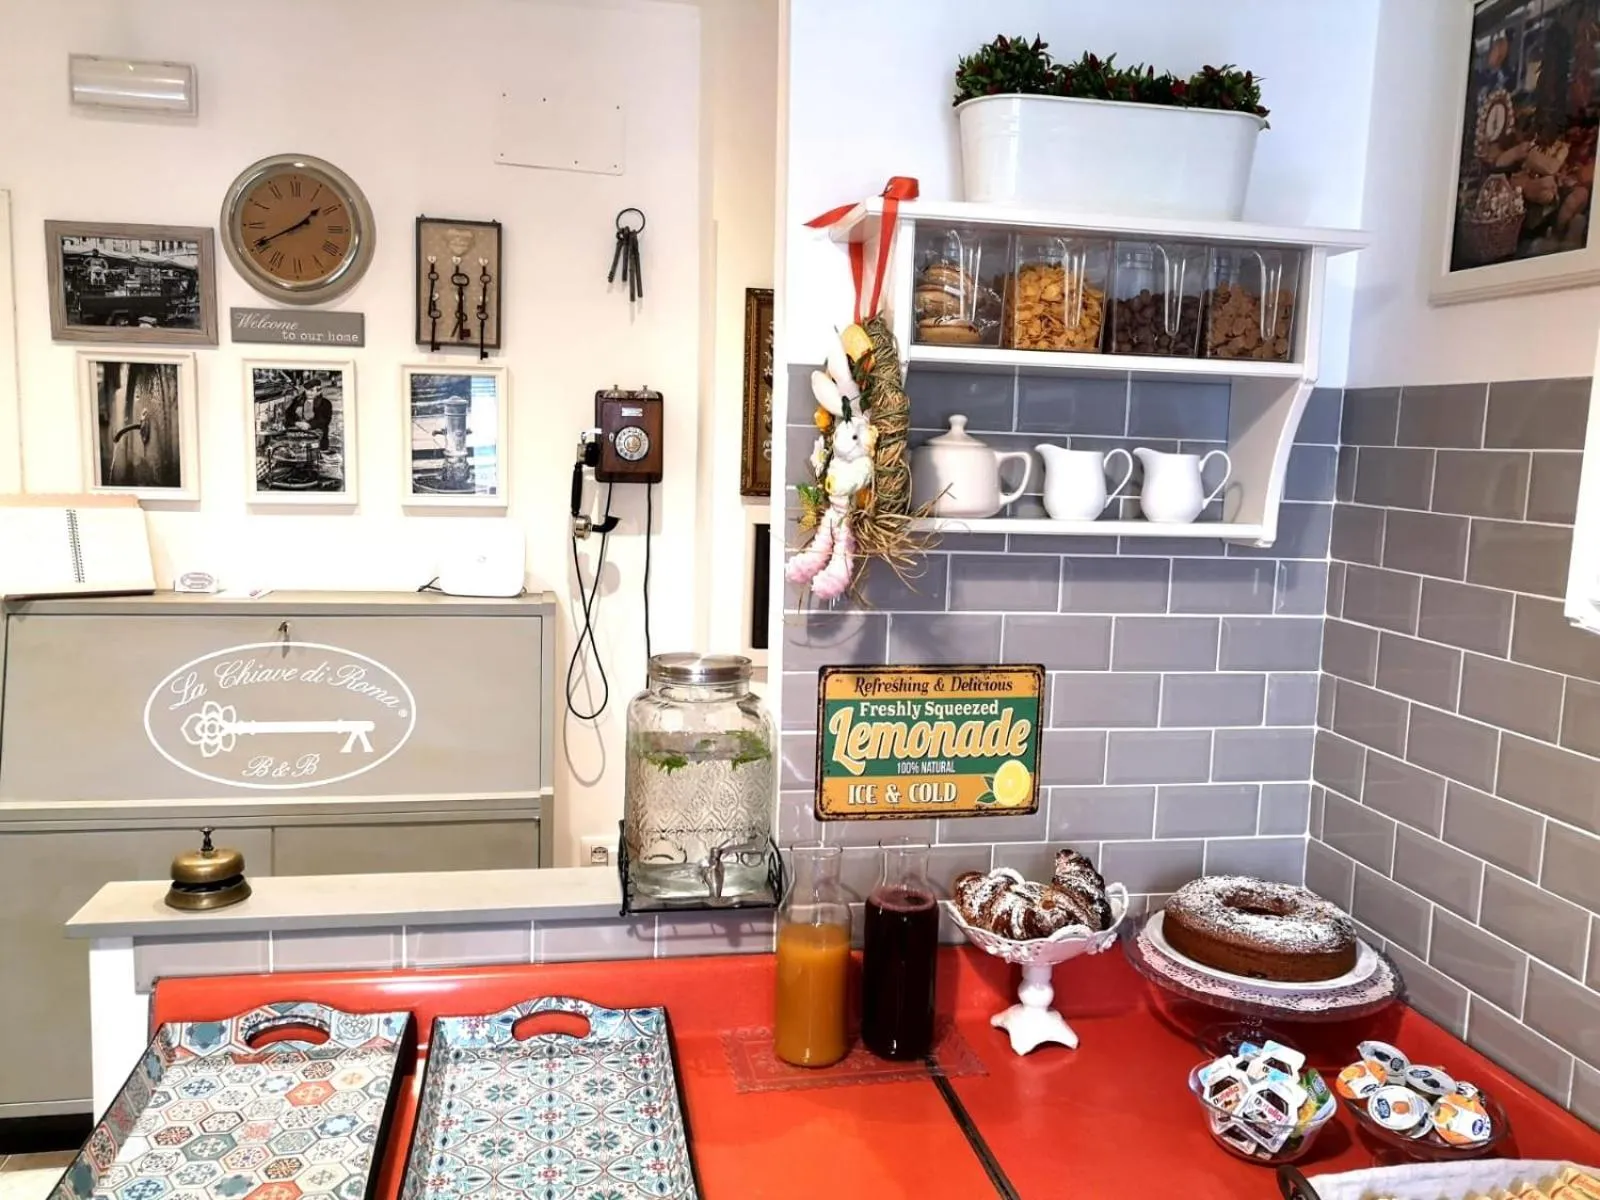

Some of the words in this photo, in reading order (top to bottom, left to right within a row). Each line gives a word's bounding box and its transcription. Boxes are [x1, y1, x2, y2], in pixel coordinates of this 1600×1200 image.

[234, 312, 299, 330] Welcome
[282, 331, 296, 340] to
[300, 332, 324, 341] our
[328, 330, 359, 342] home
[170, 672, 208, 709] La
[214, 659, 298, 689] Chiave
[299, 661, 331, 683] di
[328, 664, 401, 709] Roma
[854, 677, 930, 697] Refreshing
[933, 677, 945, 692] &
[951, 675, 1013, 693] Delicious
[859, 701, 922, 720] Freshly
[924, 700, 999, 719] Squeezed
[828, 706, 1032, 776] Lemonade
[897, 762, 920, 775] 100%
[920, 760, 956, 774] NATURAL
[848, 784, 878, 804] ICE
[884, 783, 901, 803] &
[908, 782, 957, 803] COLD
